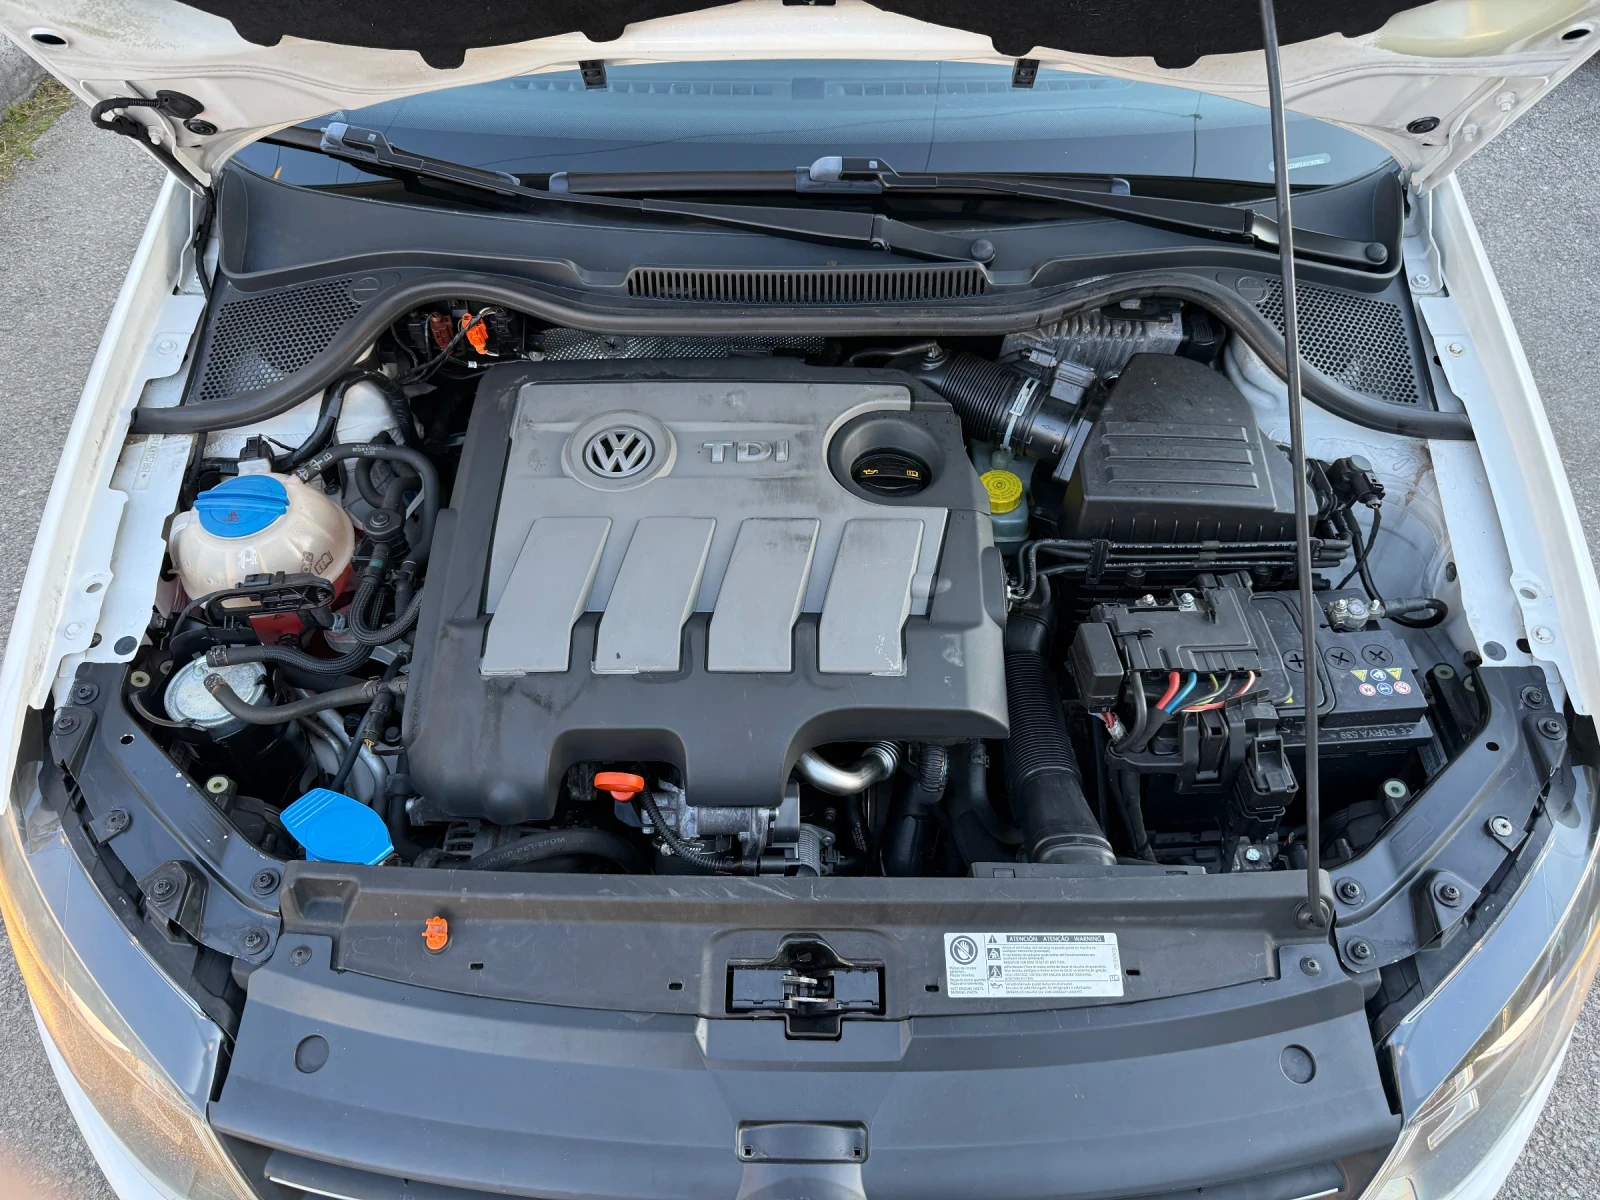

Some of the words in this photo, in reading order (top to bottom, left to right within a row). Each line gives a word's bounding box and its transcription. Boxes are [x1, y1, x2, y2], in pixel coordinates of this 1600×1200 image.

[585, 427, 654, 478] VW
[702, 440, 790, 464] TDI
[1359, 728, 1397, 738] FURYA
[1043, 934, 1070, 943] ATENÇÃO
